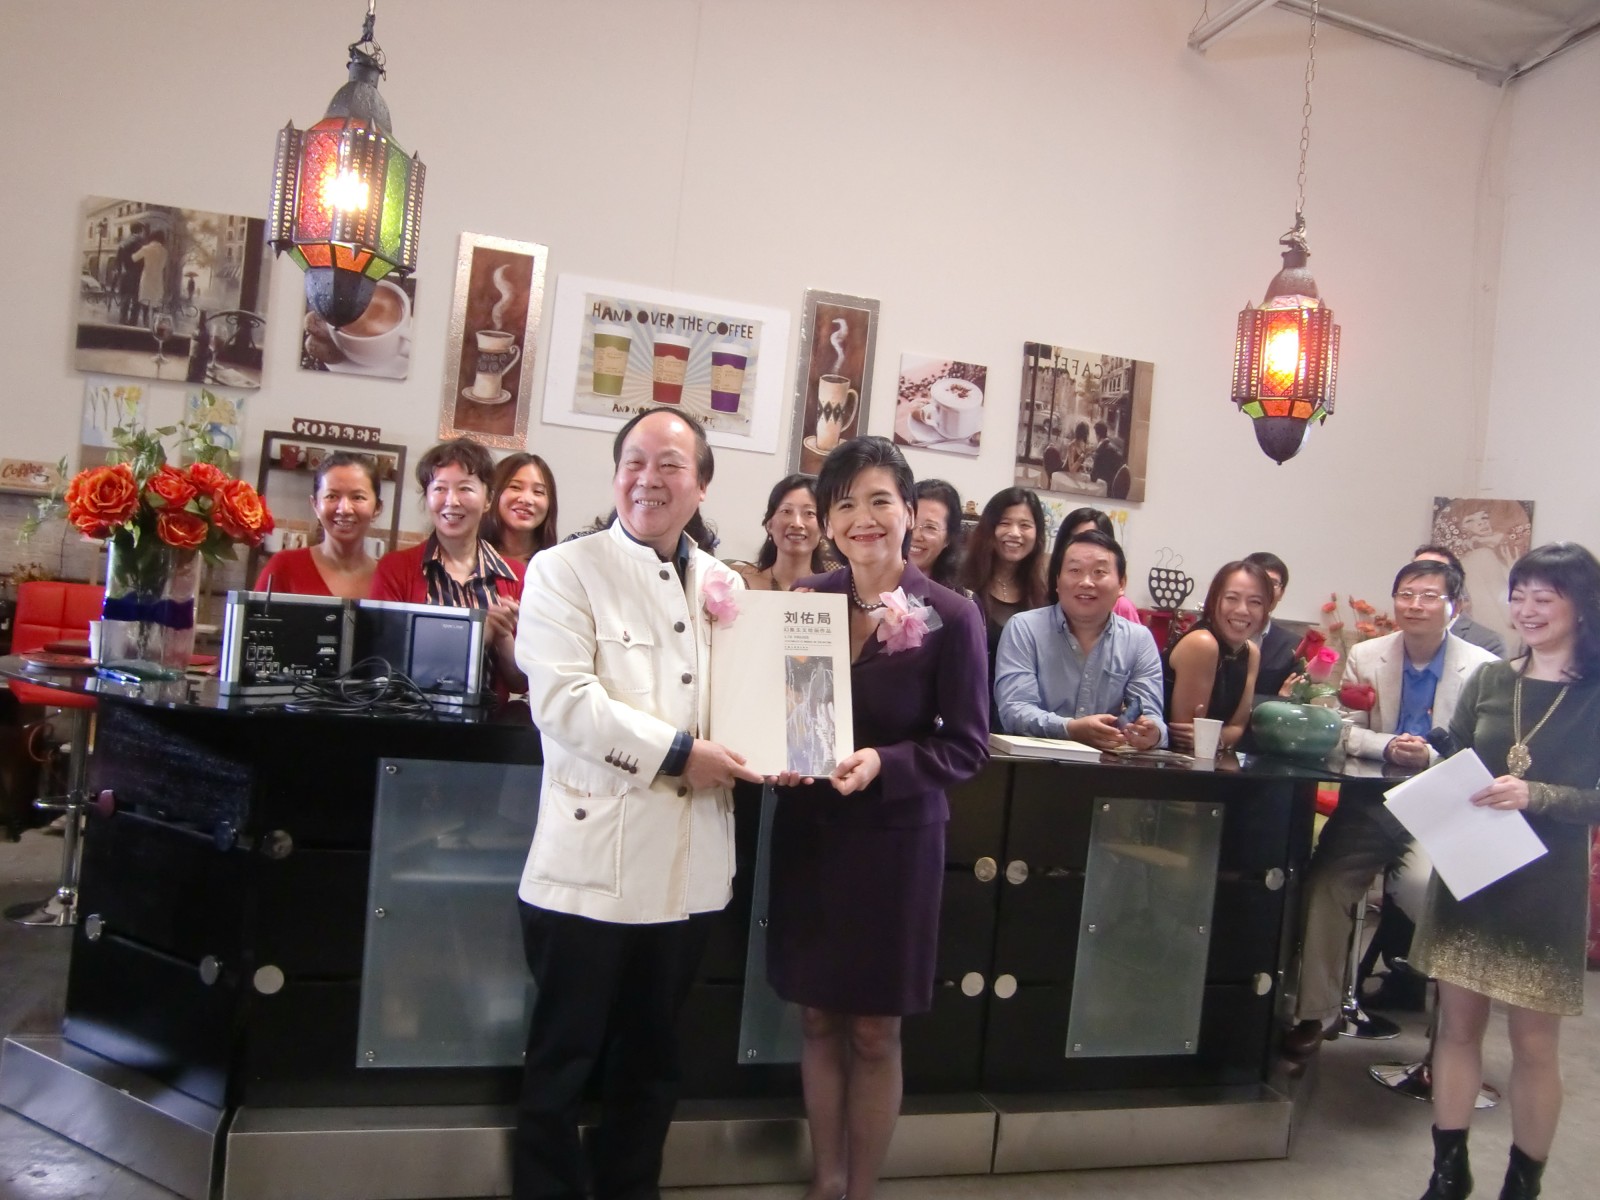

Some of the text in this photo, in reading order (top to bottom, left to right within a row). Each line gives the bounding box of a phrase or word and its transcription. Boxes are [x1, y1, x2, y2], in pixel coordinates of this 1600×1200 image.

[592, 302, 754, 339] HAND OVER THE COFFEE
[612, 403, 630, 413] AND
[292, 417, 381, 443] COFFEE
[783, 611, 831, 625] 刘佑局
